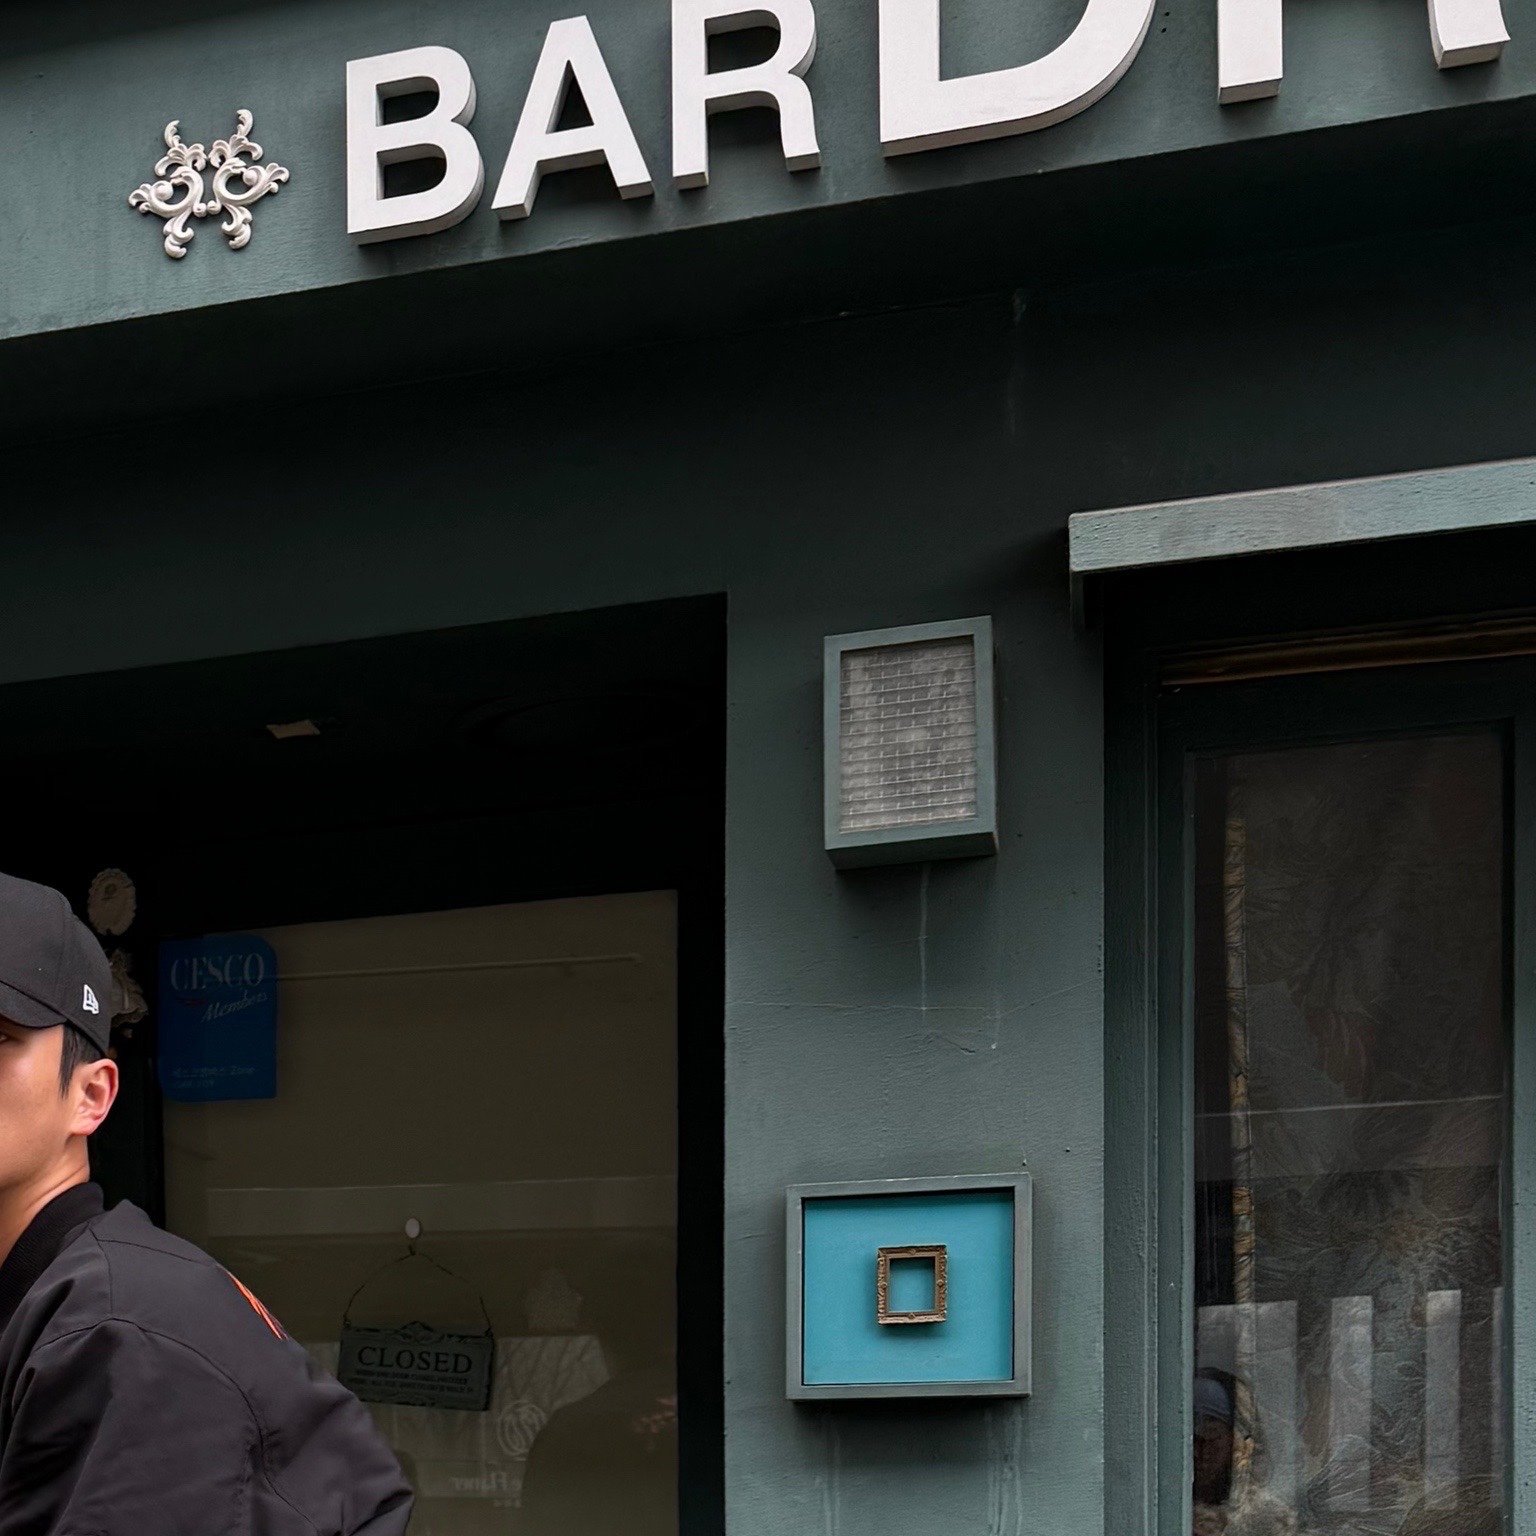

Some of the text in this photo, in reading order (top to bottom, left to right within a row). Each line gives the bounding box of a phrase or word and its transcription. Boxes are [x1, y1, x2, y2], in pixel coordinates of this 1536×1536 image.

[346, 0, 820, 245] BAR
[170, 952, 264, 990] CESCO
[357, 1346, 472, 1373] CLOSED
